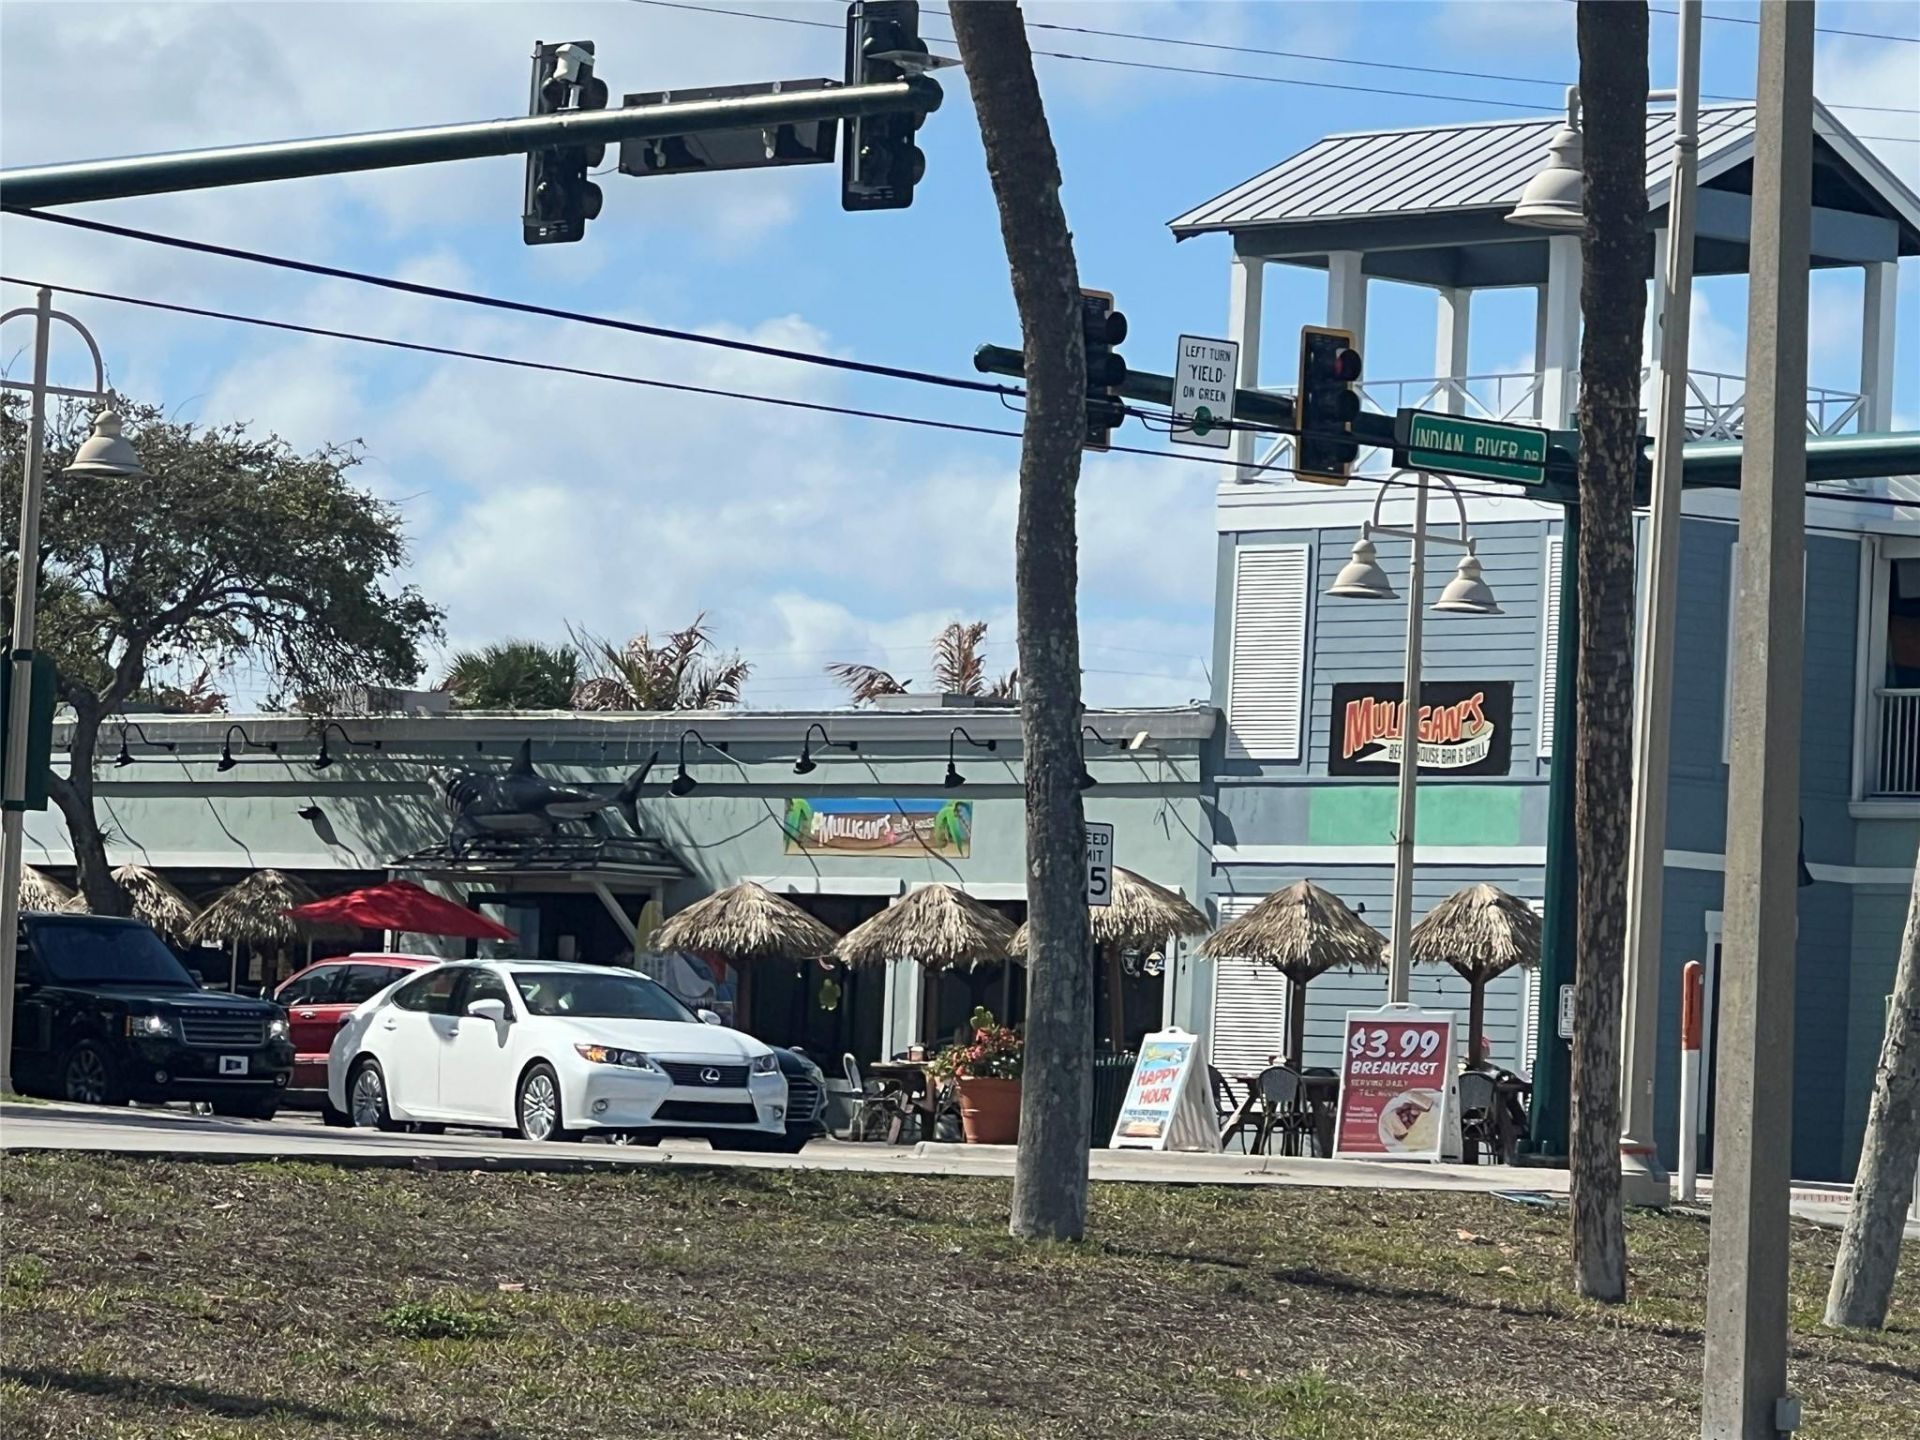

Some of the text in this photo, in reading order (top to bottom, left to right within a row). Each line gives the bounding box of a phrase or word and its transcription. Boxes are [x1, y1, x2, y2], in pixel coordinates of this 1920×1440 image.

[1185, 345, 1231, 361] LEFT TURN
[1191, 364, 1223, 383] YIELD
[1183, 385, 1226, 403] ON GREEN
[1415, 427, 1465, 453] INDIAN
[1474, 436, 1519, 463] RIVER
[1441, 748, 1457, 765] BAR
[1465, 741, 1486, 762] GRILL
[1086, 832, 1109, 846] EED
[1090, 866, 1107, 896] 5
[1350, 1027, 1440, 1058] $3.99
[1138, 1068, 1179, 1086] HAPPY
[1350, 1061, 1439, 1075] BREAKFAST
[1139, 1088, 1171, 1105] HOUR
